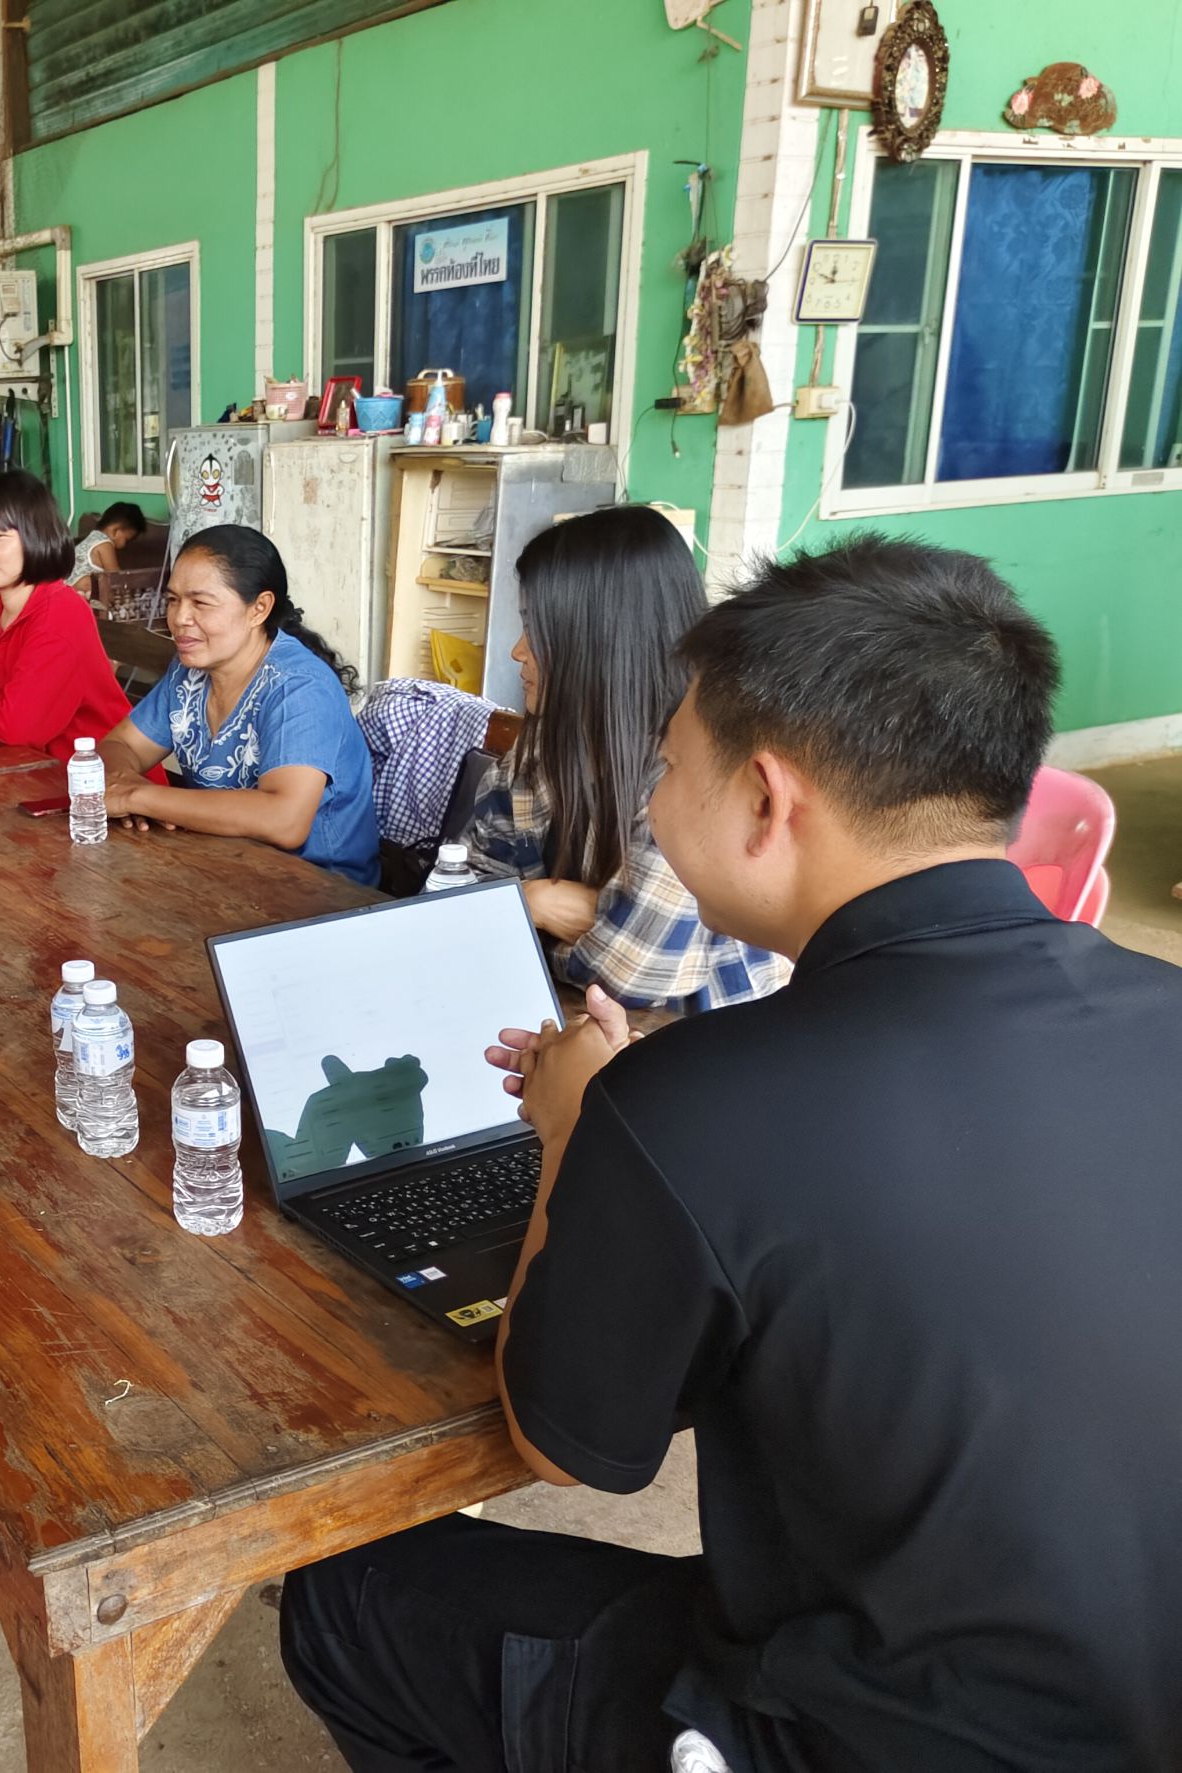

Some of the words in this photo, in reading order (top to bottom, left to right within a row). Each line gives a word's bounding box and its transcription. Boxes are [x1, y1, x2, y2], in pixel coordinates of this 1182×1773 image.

[420, 252, 500, 285] พรรคท้องที่ไทย
